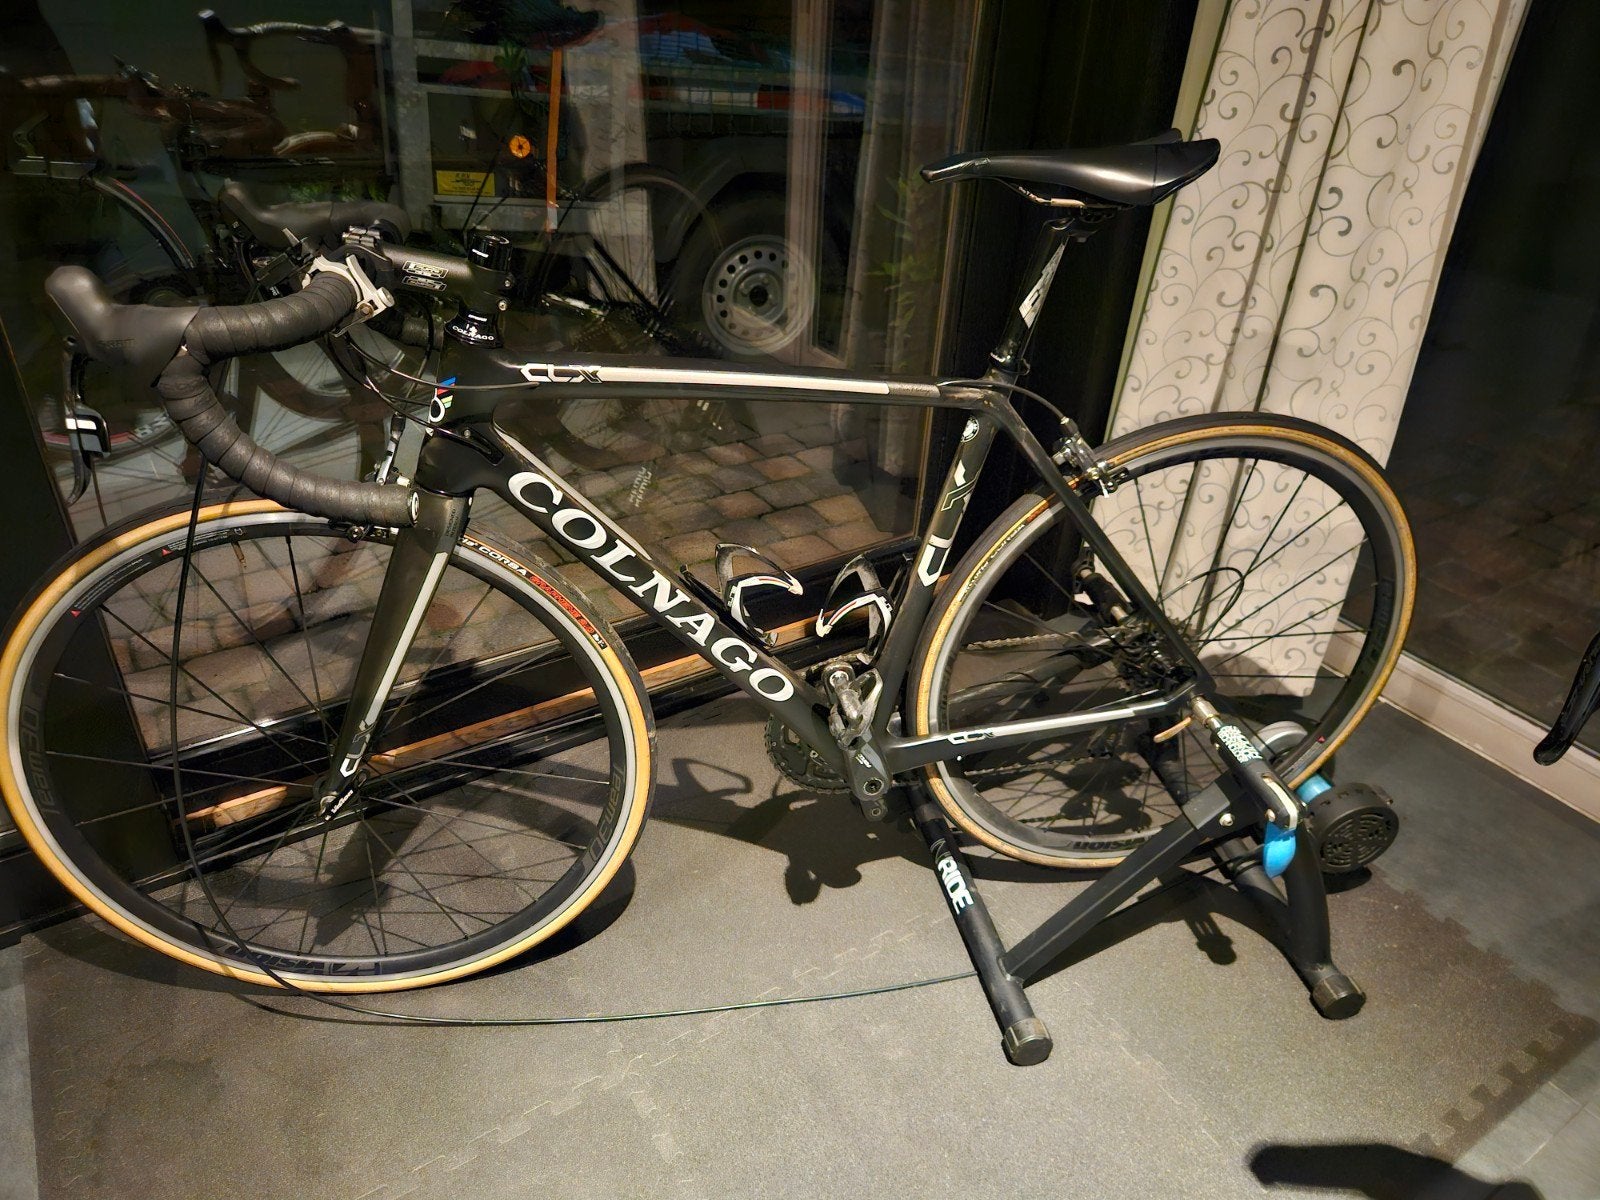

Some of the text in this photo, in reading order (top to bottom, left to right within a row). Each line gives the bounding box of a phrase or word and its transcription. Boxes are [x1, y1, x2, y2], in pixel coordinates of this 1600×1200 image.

[452, 325, 495, 341] COLNAGO
[520, 362, 602, 384] CLX
[478, 544, 527, 577] CORSA
[508, 471, 795, 702] COLNAGO
